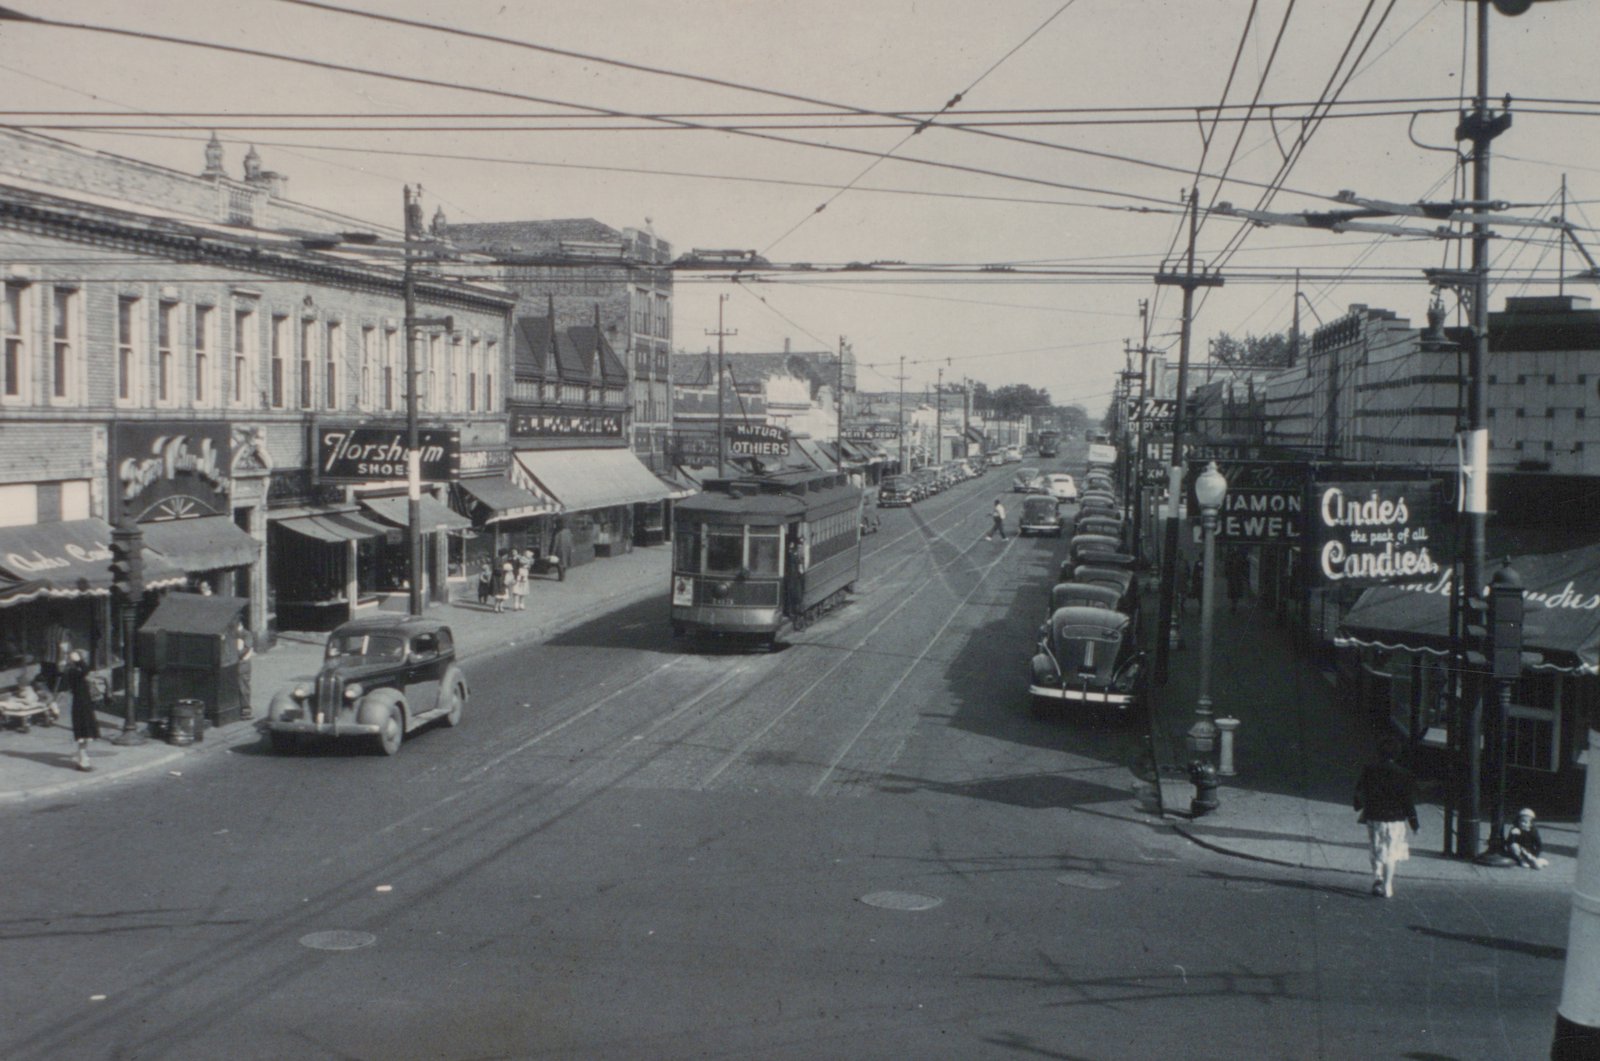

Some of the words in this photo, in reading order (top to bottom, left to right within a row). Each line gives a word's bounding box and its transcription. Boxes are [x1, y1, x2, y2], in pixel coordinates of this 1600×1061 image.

[737, 424, 784, 440] MUTUAL
[1225, 494, 1301, 512] IAMON
[1321, 487, 1409, 527] Andes
[1213, 516, 1301, 537] JEWEL
[1349, 528, 1368, 543] the
[1370, 528, 1394, 546] peak
[1397, 527, 1410, 545] of
[1412, 527, 1429, 541] all
